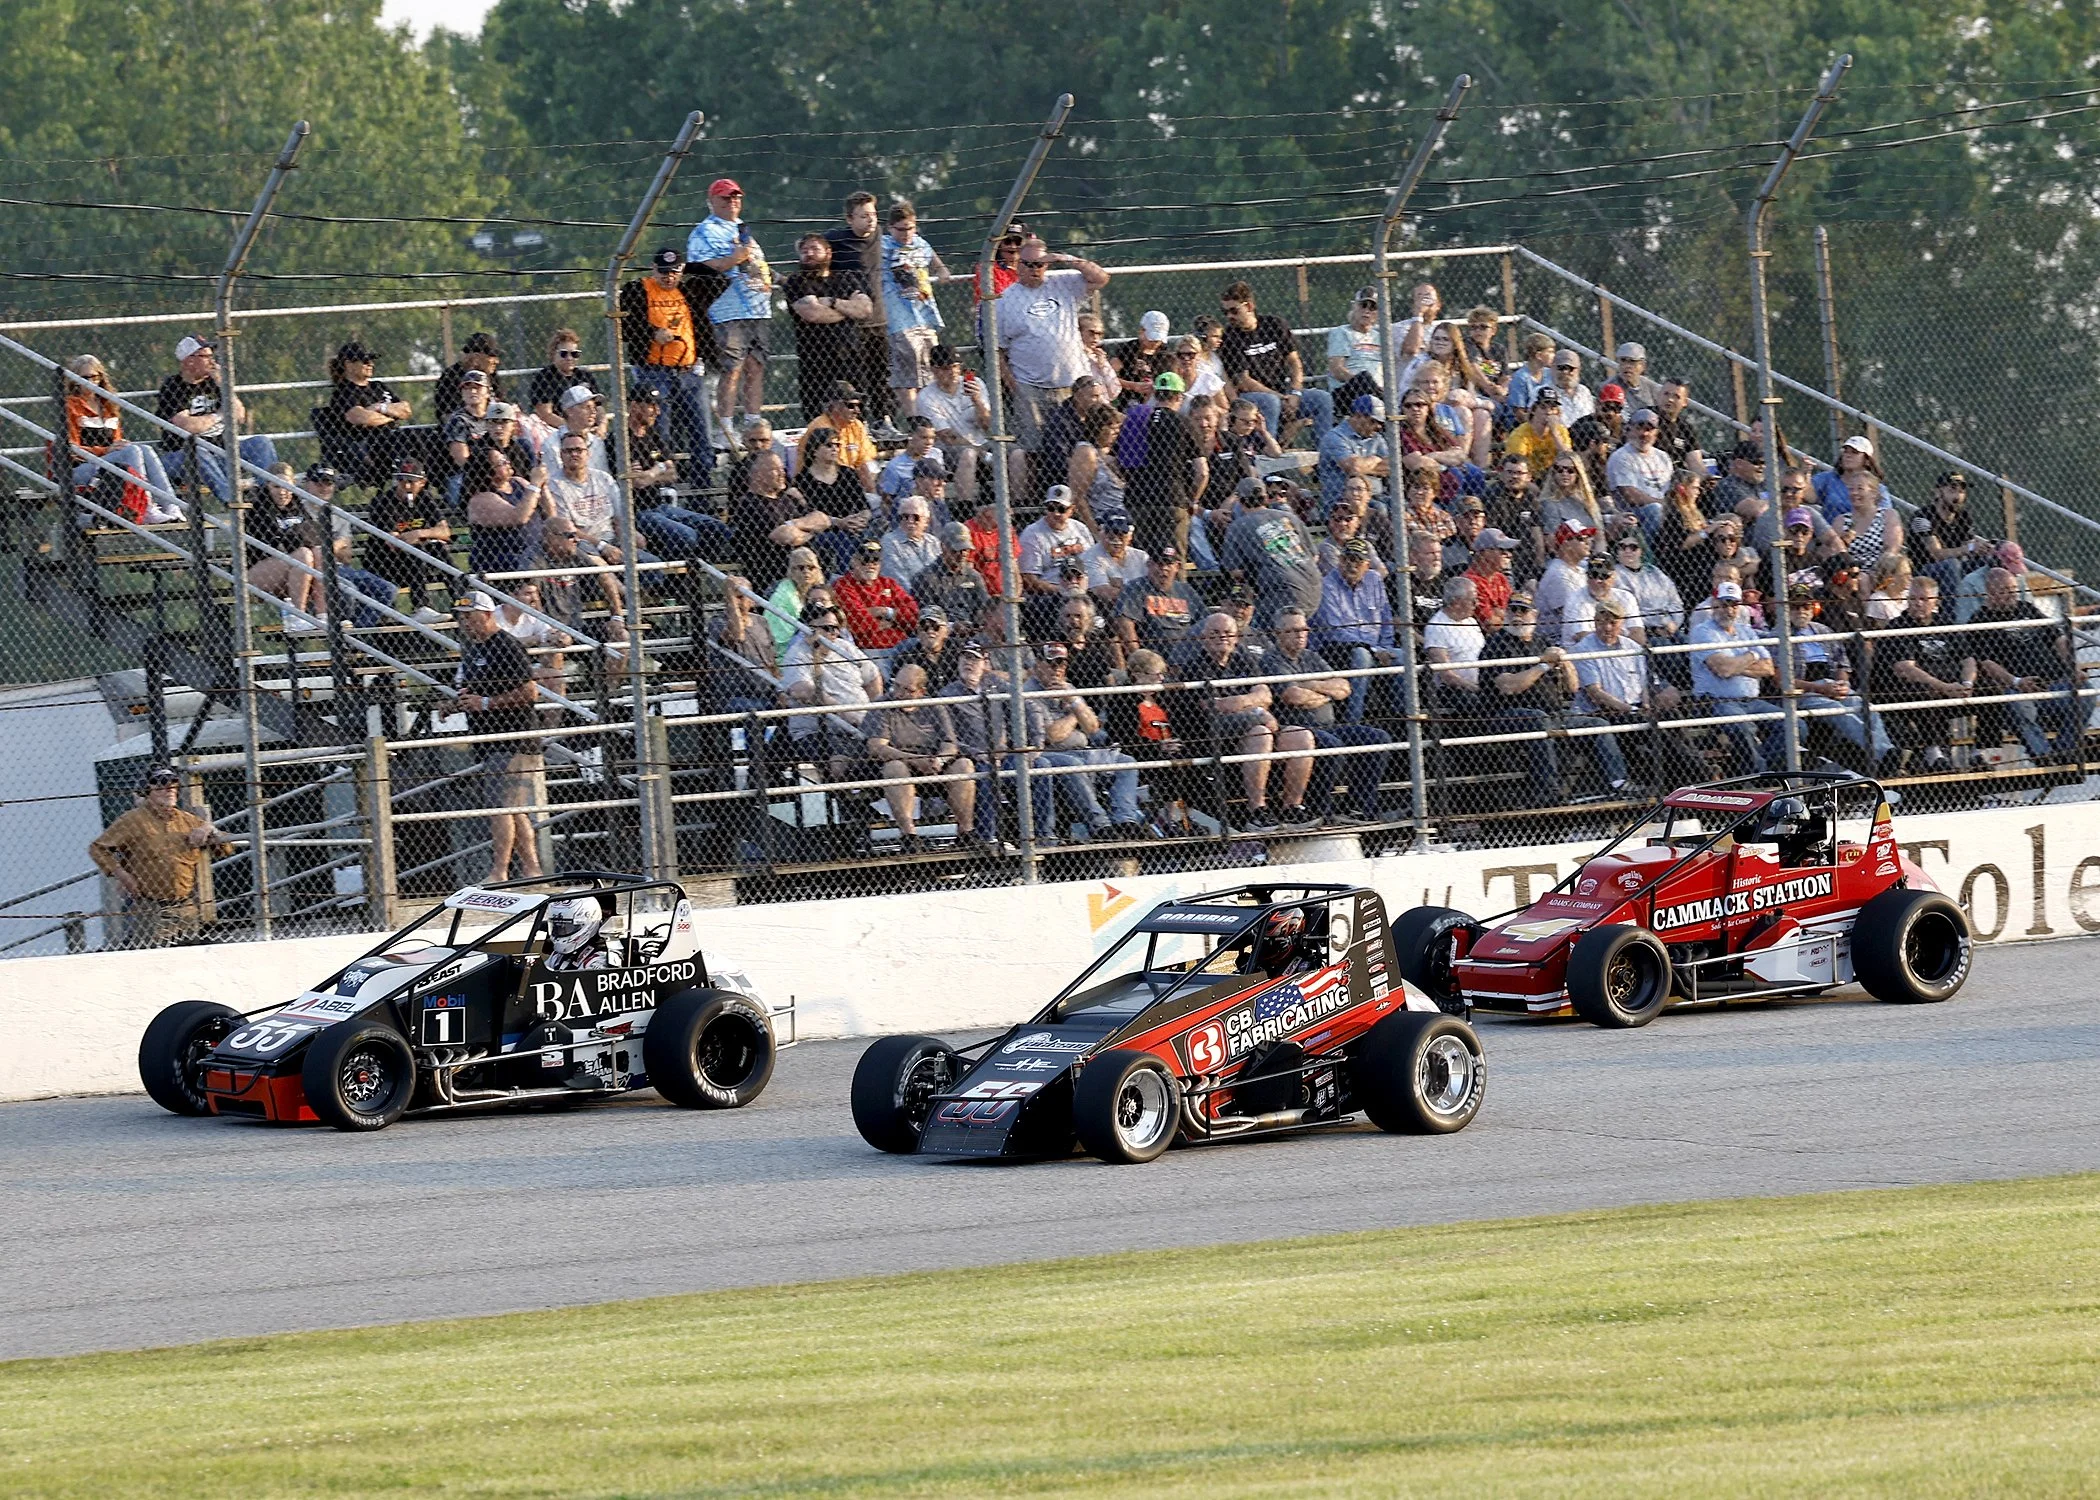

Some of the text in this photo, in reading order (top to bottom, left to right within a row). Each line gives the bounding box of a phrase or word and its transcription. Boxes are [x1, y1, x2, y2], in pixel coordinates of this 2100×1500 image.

[1732, 874, 1762, 889] Historic
[458, 893, 521, 908] FERNS
[1653, 872, 1831, 930] CAMMACK STATION
[1501, 918, 1583, 942] 4
[597, 962, 696, 992] BRADFORD
[311, 999, 356, 1013] ABEL
[423, 993, 466, 1008] Mobil
[529, 977, 597, 1021] BA
[599, 990, 656, 1015] ALLEN
[435, 1011, 449, 1042] 1
[1226, 1008, 1254, 1035] CB
[1229, 985, 1350, 1058] FABRICATING
[230, 1020, 314, 1052] 55
